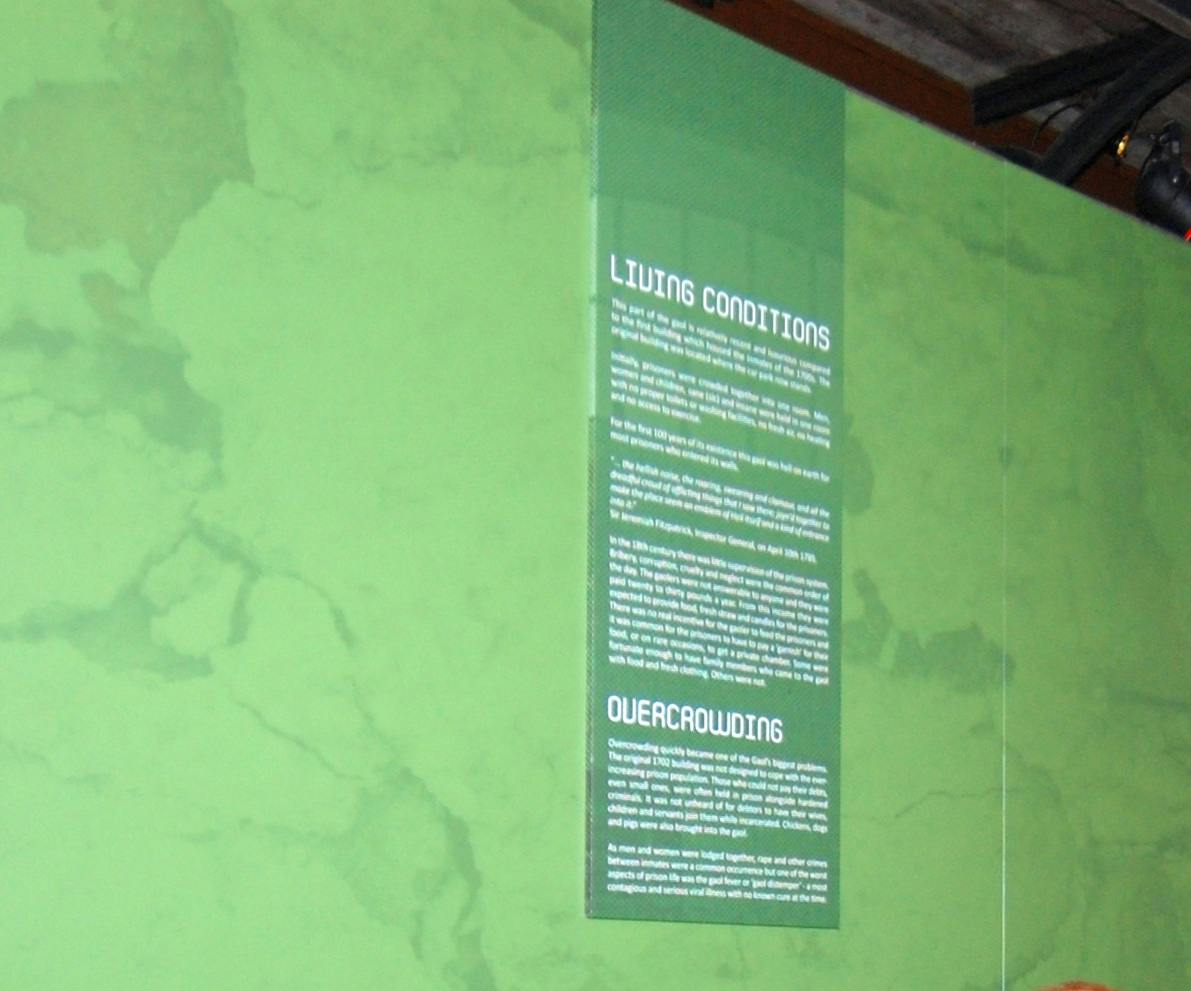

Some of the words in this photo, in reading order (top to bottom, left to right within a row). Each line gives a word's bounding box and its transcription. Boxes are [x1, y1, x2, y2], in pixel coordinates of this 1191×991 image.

[610, 254, 694, 307] LIVING
[703, 286, 830, 352] CONDITIONS
[607, 695, 783, 743] OVERCROWDING
